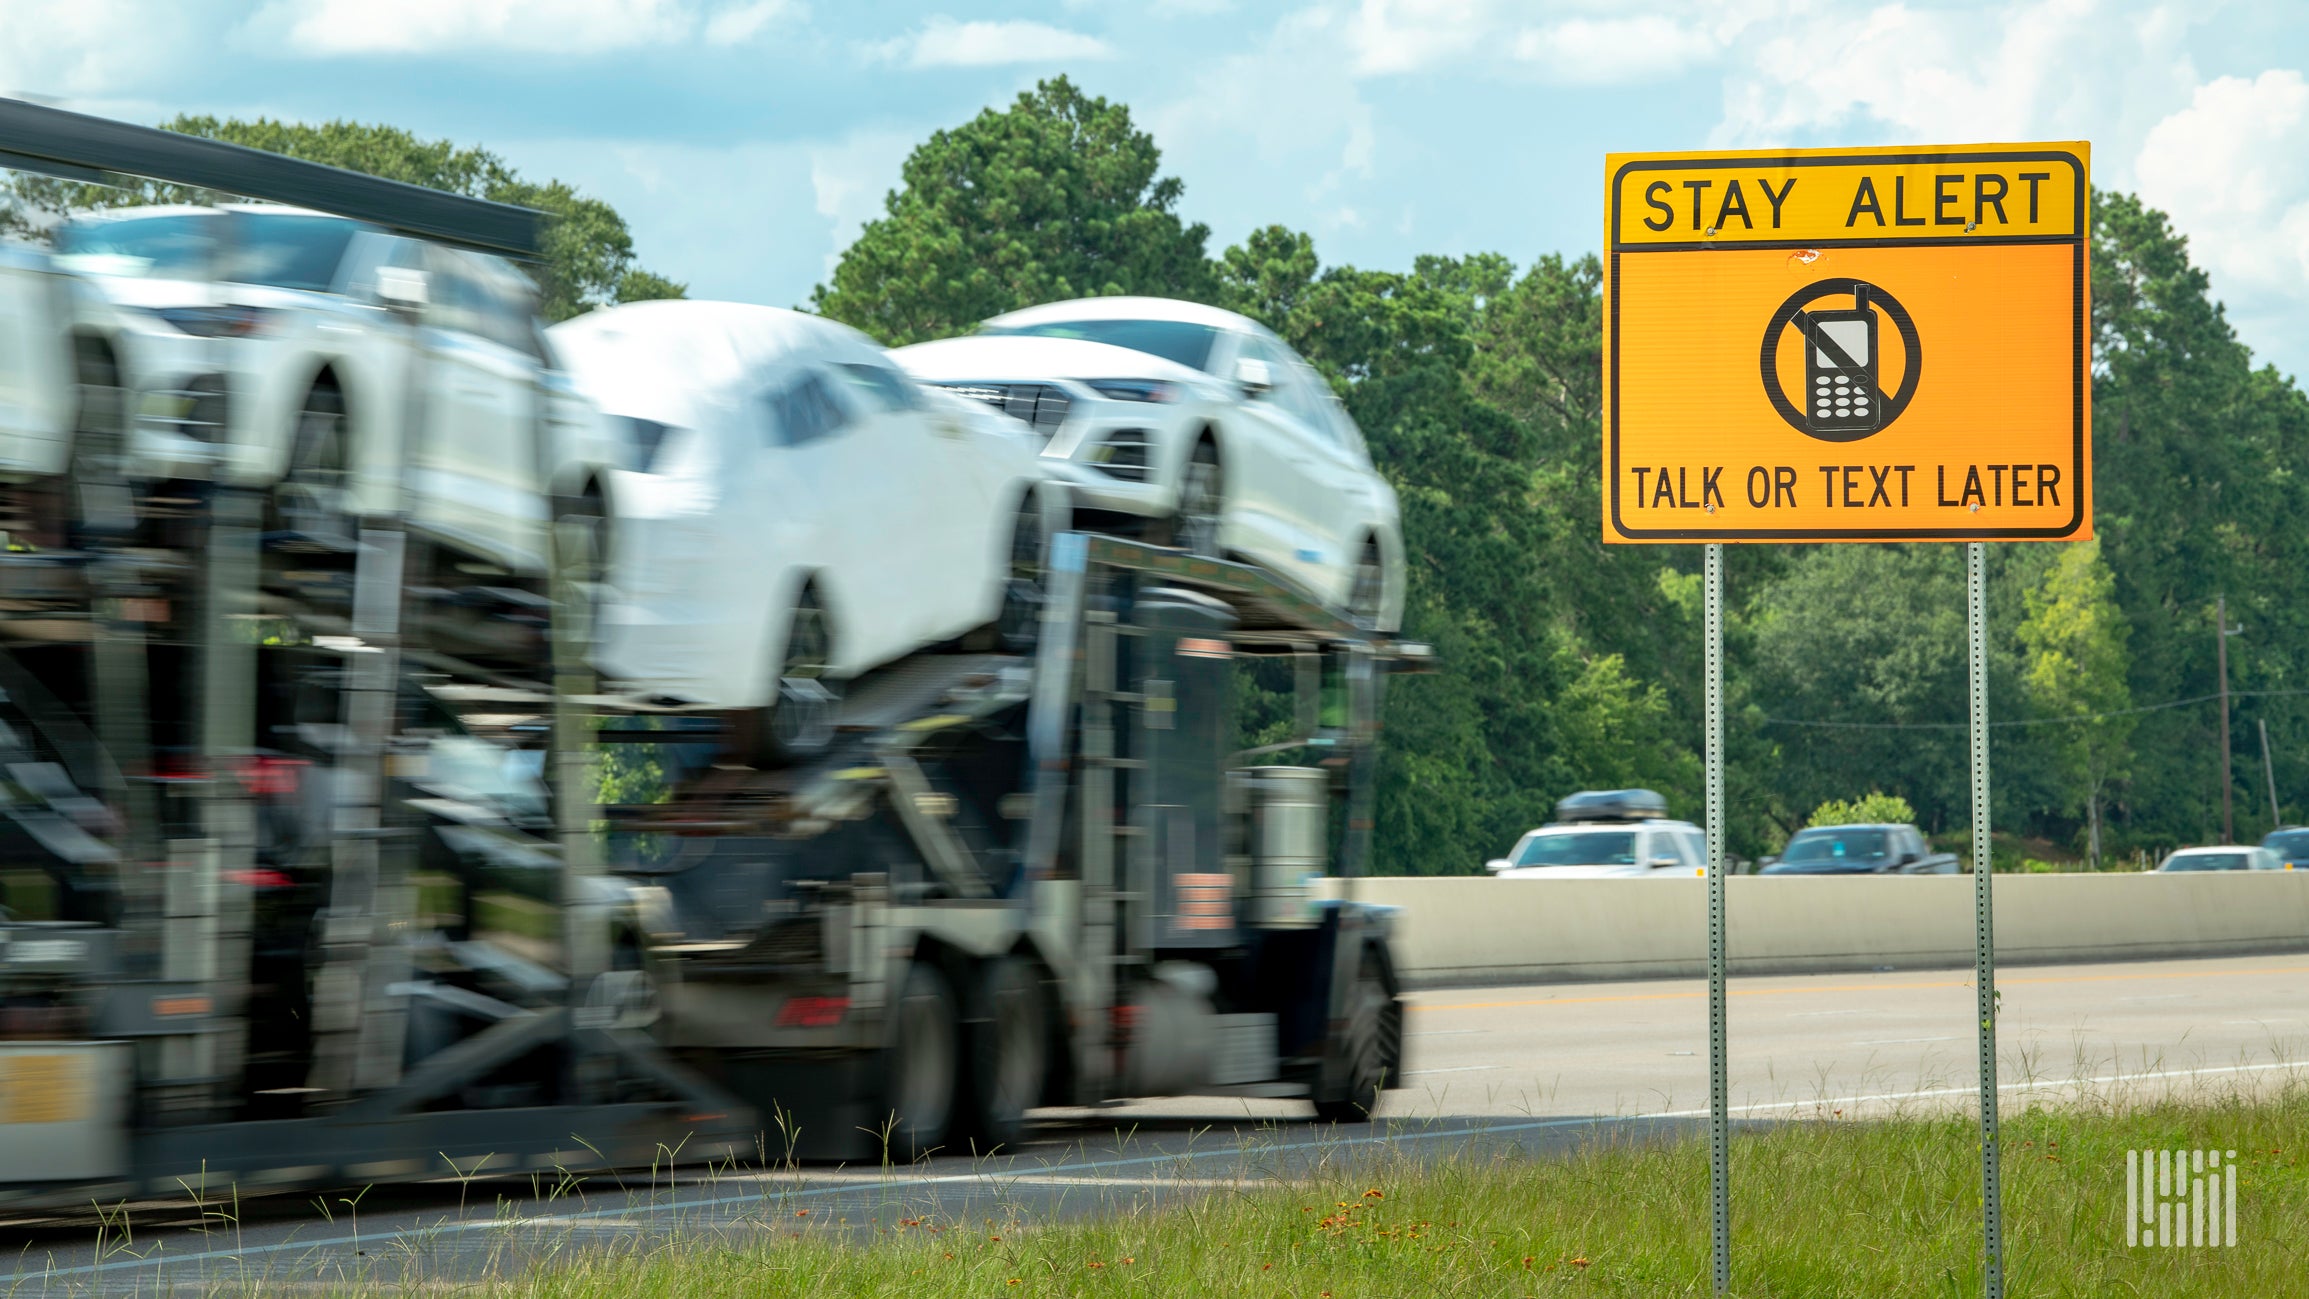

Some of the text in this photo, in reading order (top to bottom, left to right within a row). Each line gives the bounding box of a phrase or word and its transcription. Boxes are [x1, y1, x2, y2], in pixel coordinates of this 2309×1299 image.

[1643, 172, 2050, 231] STAY ALERT
[1631, 464, 2061, 509] TALK OR TEXT LATER
